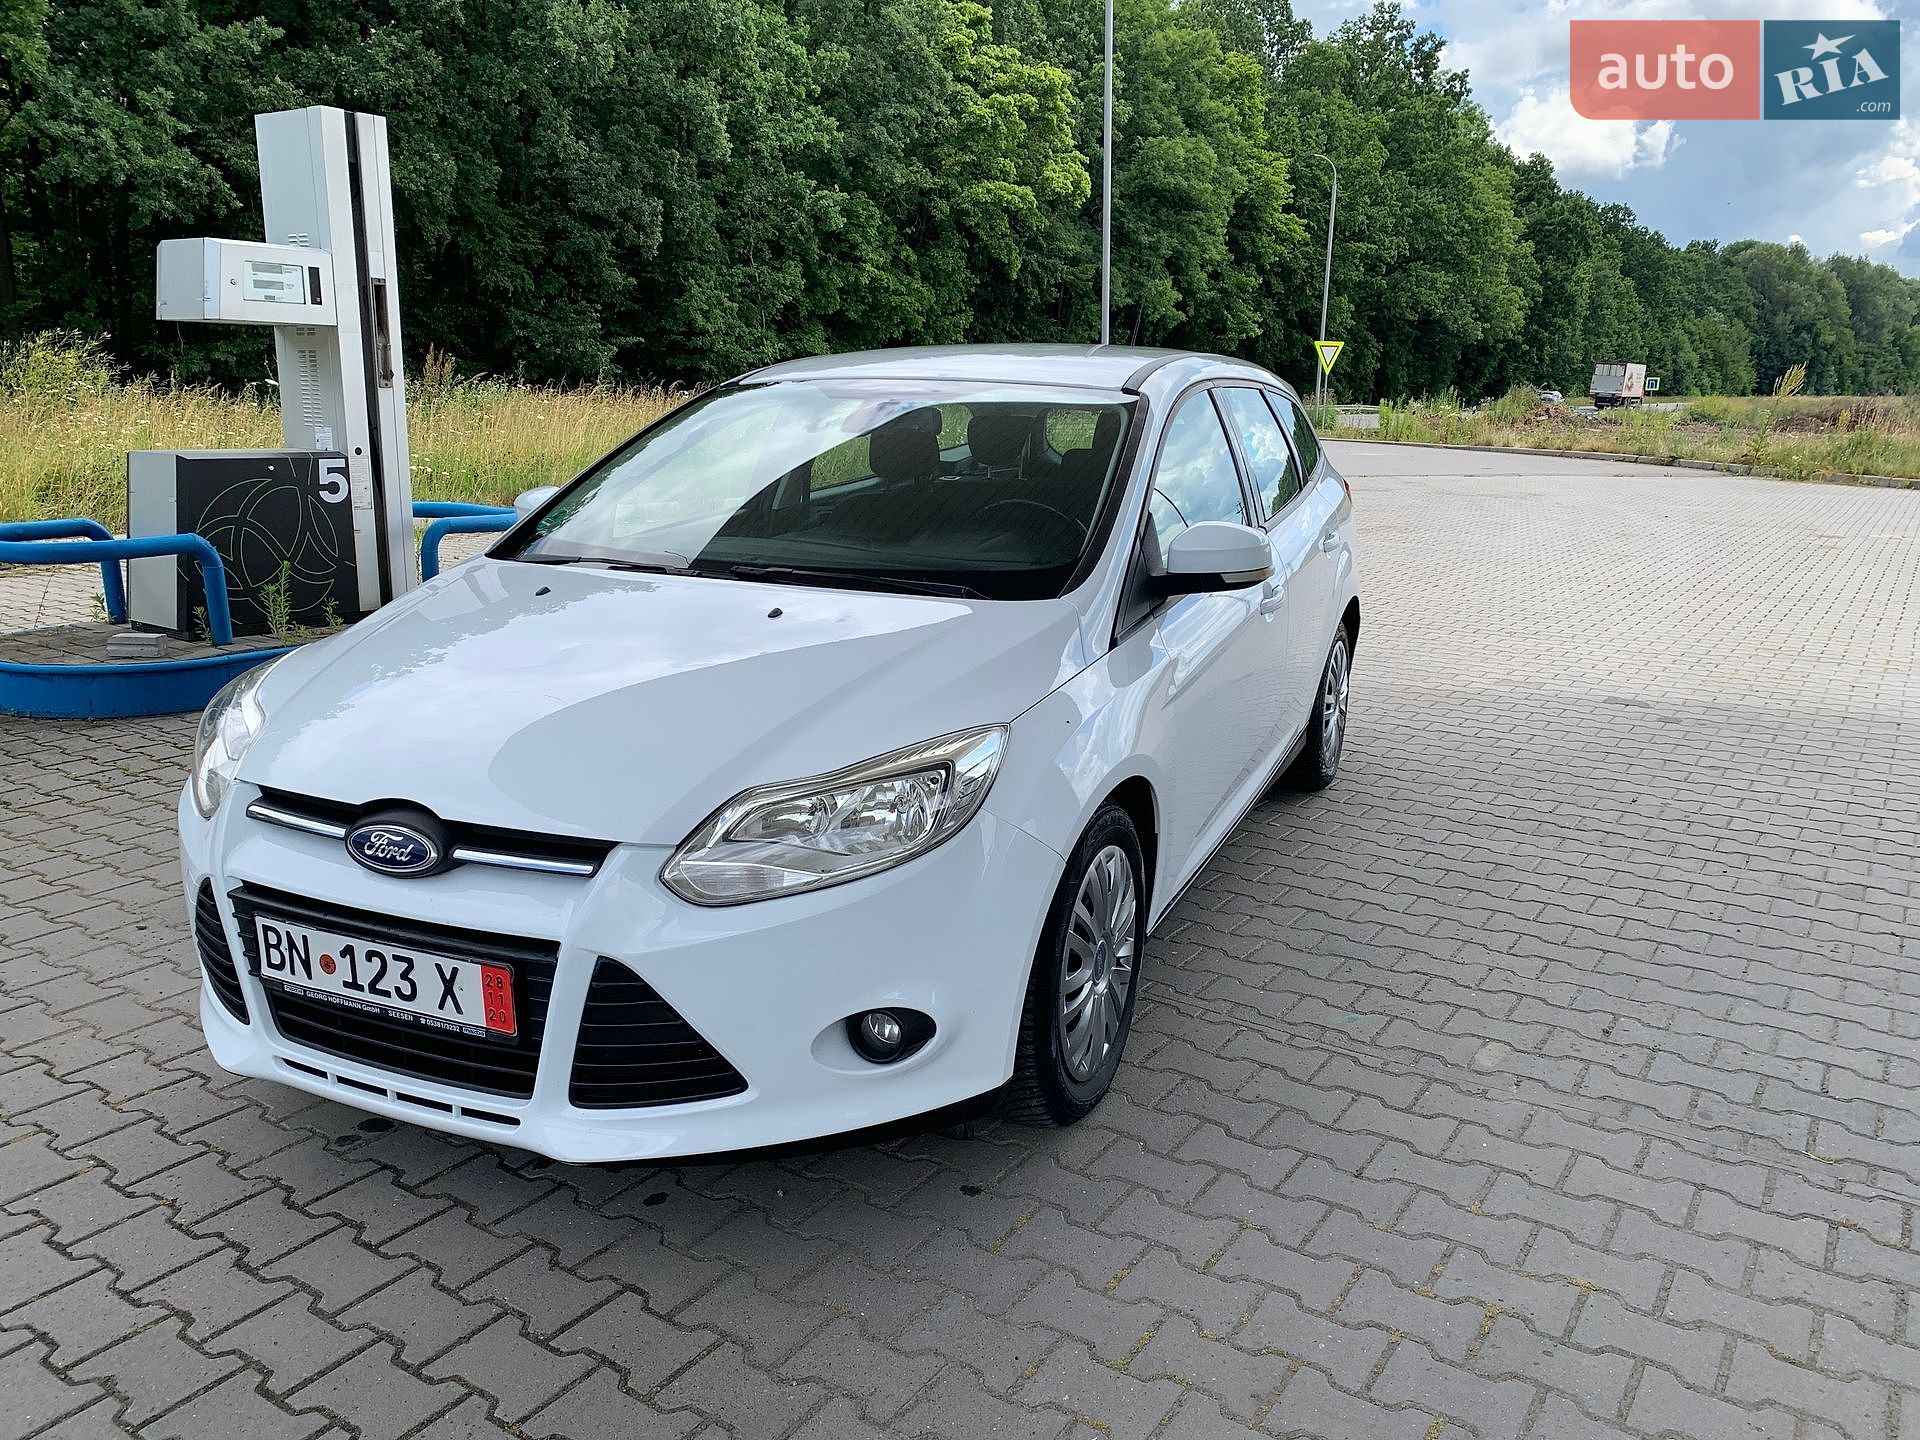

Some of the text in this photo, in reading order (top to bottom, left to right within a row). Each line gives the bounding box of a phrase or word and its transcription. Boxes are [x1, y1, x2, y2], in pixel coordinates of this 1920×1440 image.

[318, 458, 350, 504] 5
[364, 831, 414, 861] Ford
[261, 923, 464, 1015] BN 123 X
[485, 974, 503, 989] 28
[306, 990, 327, 1001] GEORG
[328, 996, 361, 1010] HOFFMANN
[388, 1010, 413, 1021] SEESEN
[488, 991, 505, 1007] 11
[488, 1008, 506, 1023] 20
